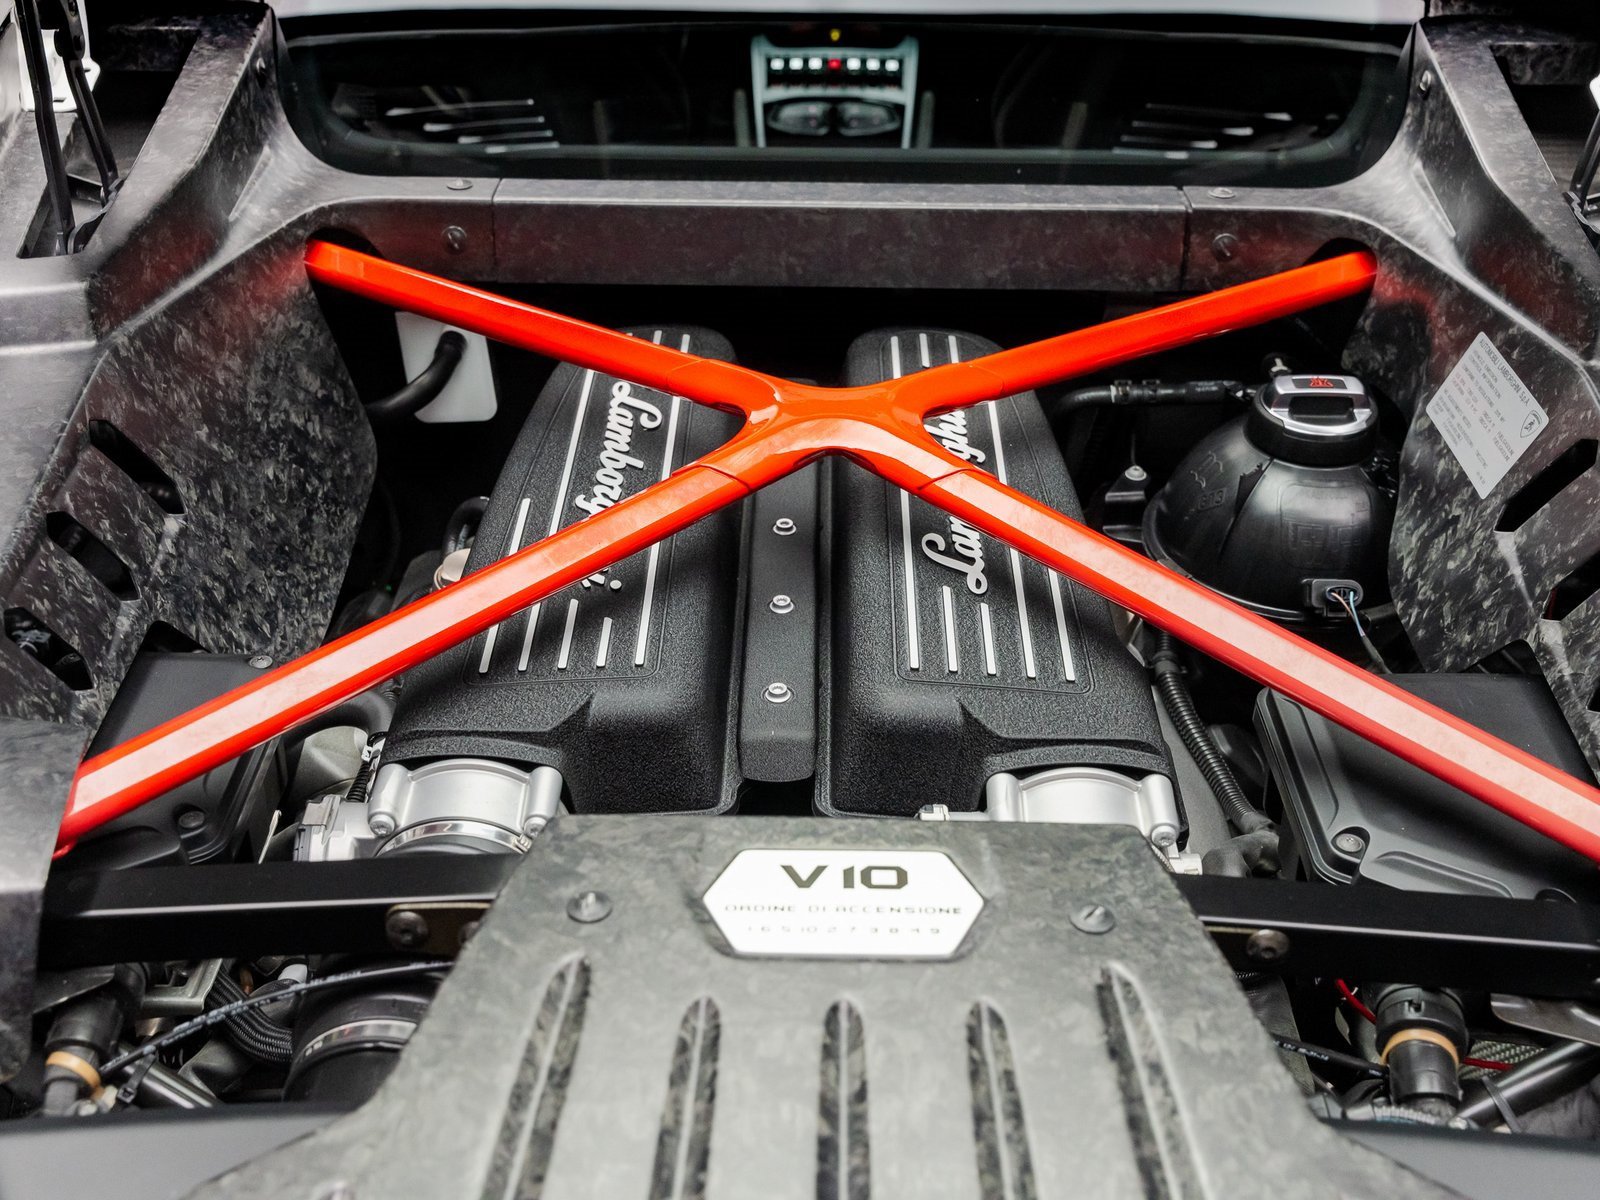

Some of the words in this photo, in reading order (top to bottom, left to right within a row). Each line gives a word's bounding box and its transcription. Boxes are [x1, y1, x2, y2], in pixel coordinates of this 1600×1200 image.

[1497, 361, 1522, 394] LAMBORGHINI
[780, 865, 908, 889] V10
[725, 904, 796, 912] ORDINE
[836, 906, 962, 914] ACCENSIONE
